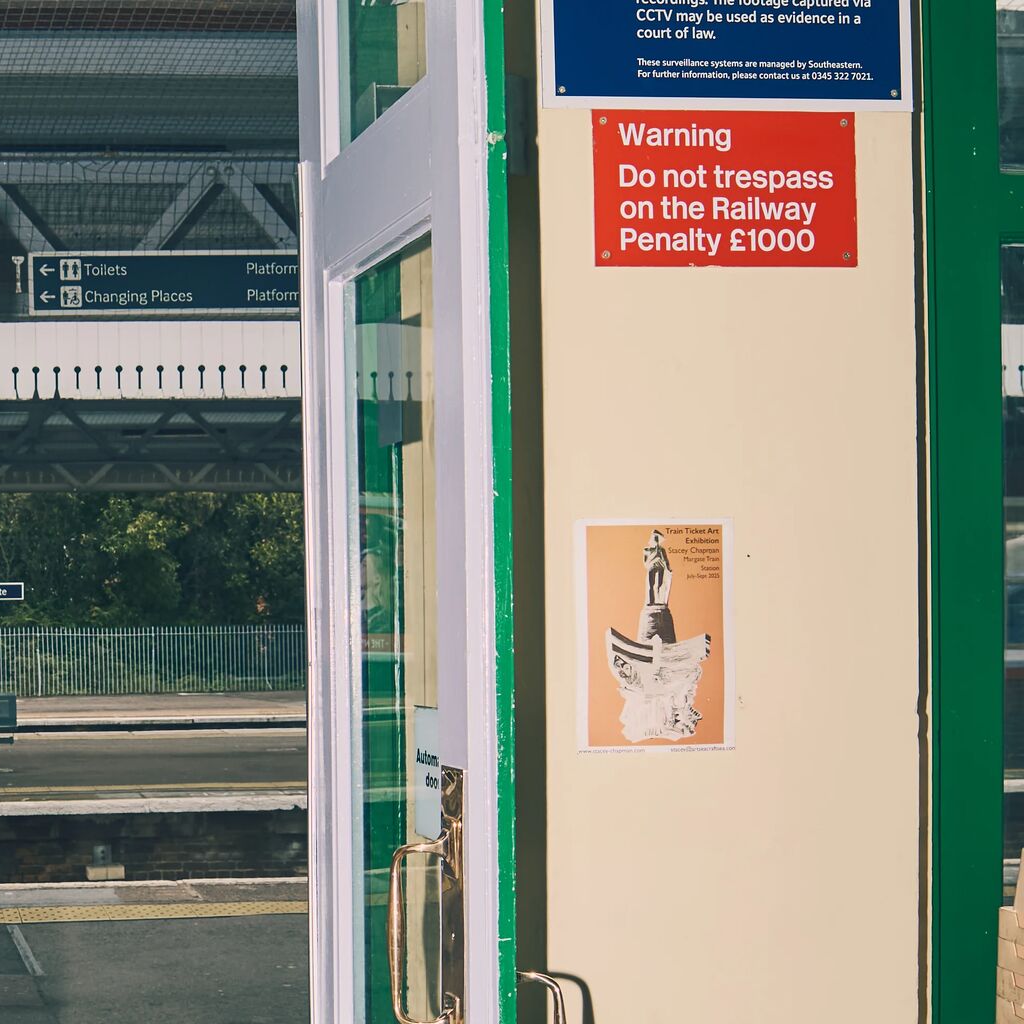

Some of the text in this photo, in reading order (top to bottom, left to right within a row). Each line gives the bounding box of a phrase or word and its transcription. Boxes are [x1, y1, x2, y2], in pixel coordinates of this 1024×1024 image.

[636, 9, 862, 25] CCTV may be used as evidence in a
[636, 27, 716, 40] court of law.
[637, 58, 661, 67] These
[662, 59, 709, 68] surveillance
[710, 61, 743, 69] systems
[759, 60, 795, 70] managed
[797, 60, 807, 70] by
[808, 60, 863, 69] Southeastern.
[637, 70, 651, 78] For
[652, 70, 680, 79] further
[681, 70, 730, 80] information,
[731, 71, 757, 80] please
[759, 72, 789, 80] contact
[811, 72, 832, 80] 0345
[834, 72, 850, 80] 322
[851, 72, 874, 80] 7021.
[619, 123, 731, 151] Warning
[619, 164, 834, 192] Do not trespass
[620, 196, 817, 225] on the Railway
[619, 228, 815, 256] Penalty £1000
[84, 262, 298, 276] Toilets Platform
[85, 289, 299, 305] Changing Places Platform
